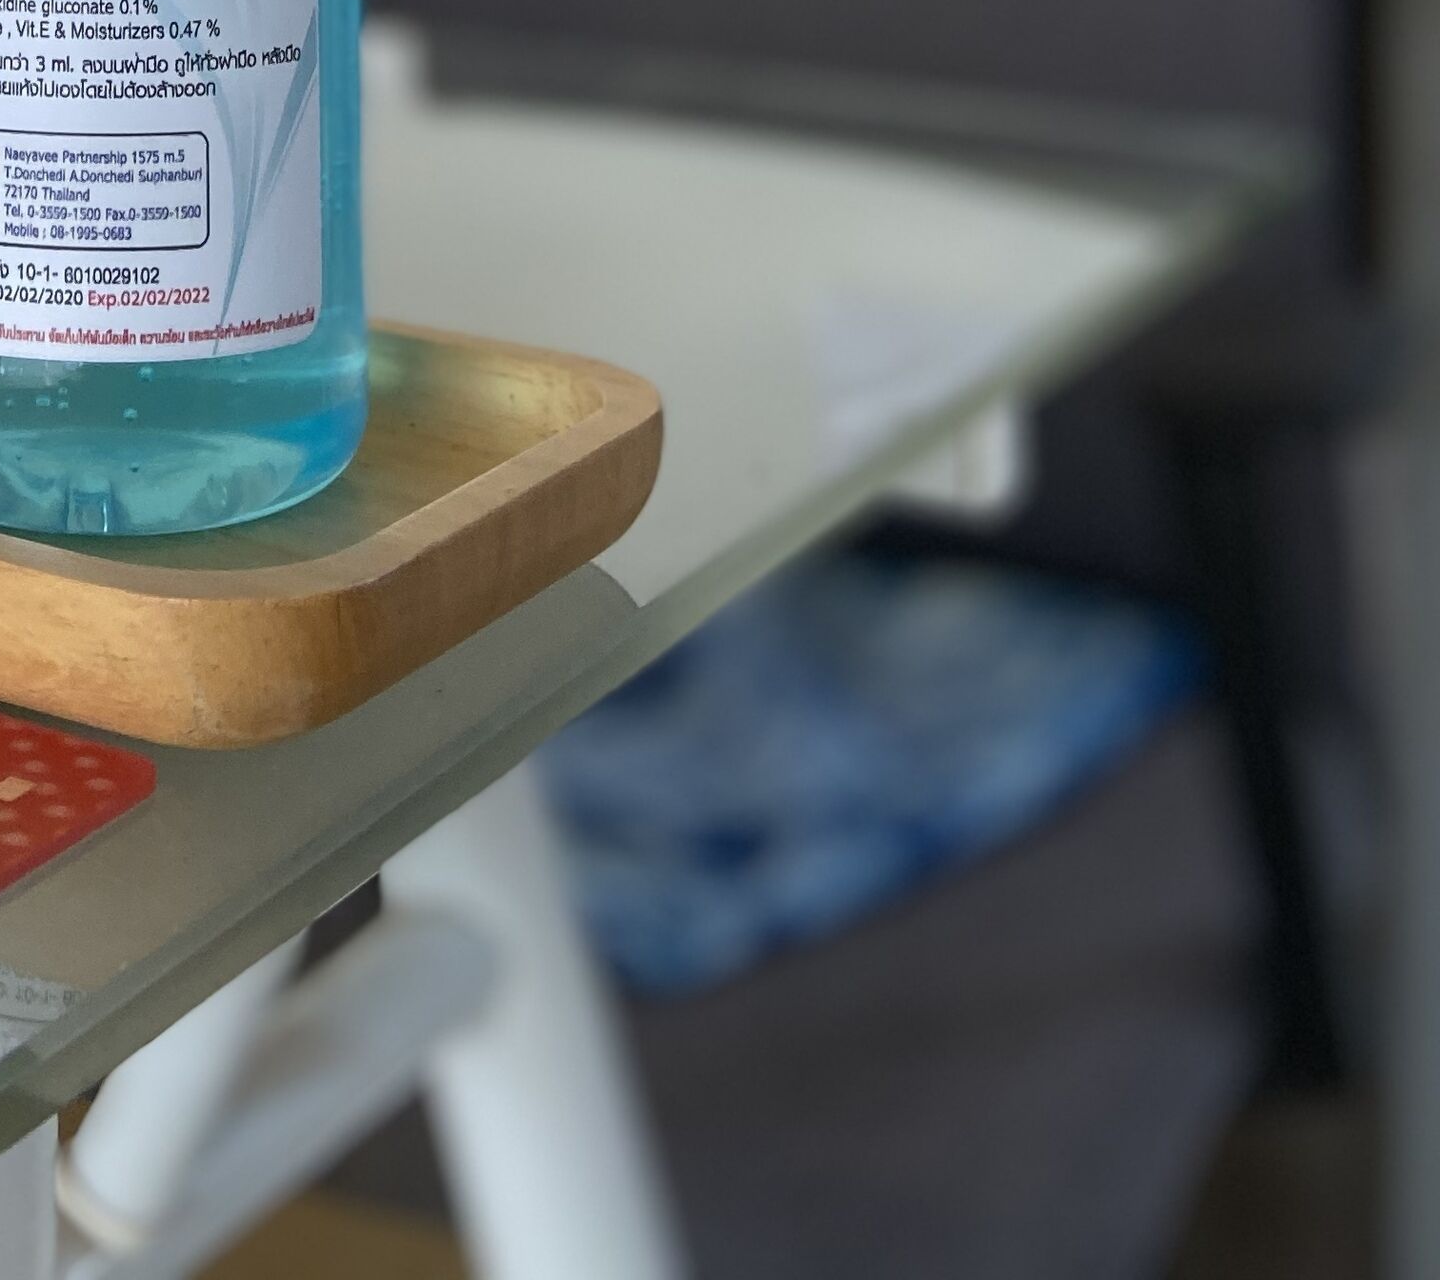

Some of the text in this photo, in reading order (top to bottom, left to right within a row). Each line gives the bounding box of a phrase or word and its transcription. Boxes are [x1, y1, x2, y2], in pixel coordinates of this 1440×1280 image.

[15, 19, 50, 40] Vit.E
[54, 21, 66, 40] &
[71, 21, 165, 41] Moisturizers
[169, 20, 201, 40] 0.47
[206, 18, 221, 38] %
[35, 55, 46, 73] 3
[51, 55, 75, 73] ml.
[81, 52, 169, 75] ลงบนฝ่ามือ
[174, 48, 257, 77] ถูให้ทั่วฝ่ามือ
[261, 44, 301, 66] หลังมือ
[62, 148, 128, 167] Partnership
[131, 149, 160, 164] 1575
[4, 165, 66, 183] T.Donchedi
[69, 167, 134, 184] A.Donchedi
[4, 183, 91, 203] 72170 Thailand
[4, 222, 40, 239] Mobile
[87, 286, 210, 311] Exp.02/02/2022
